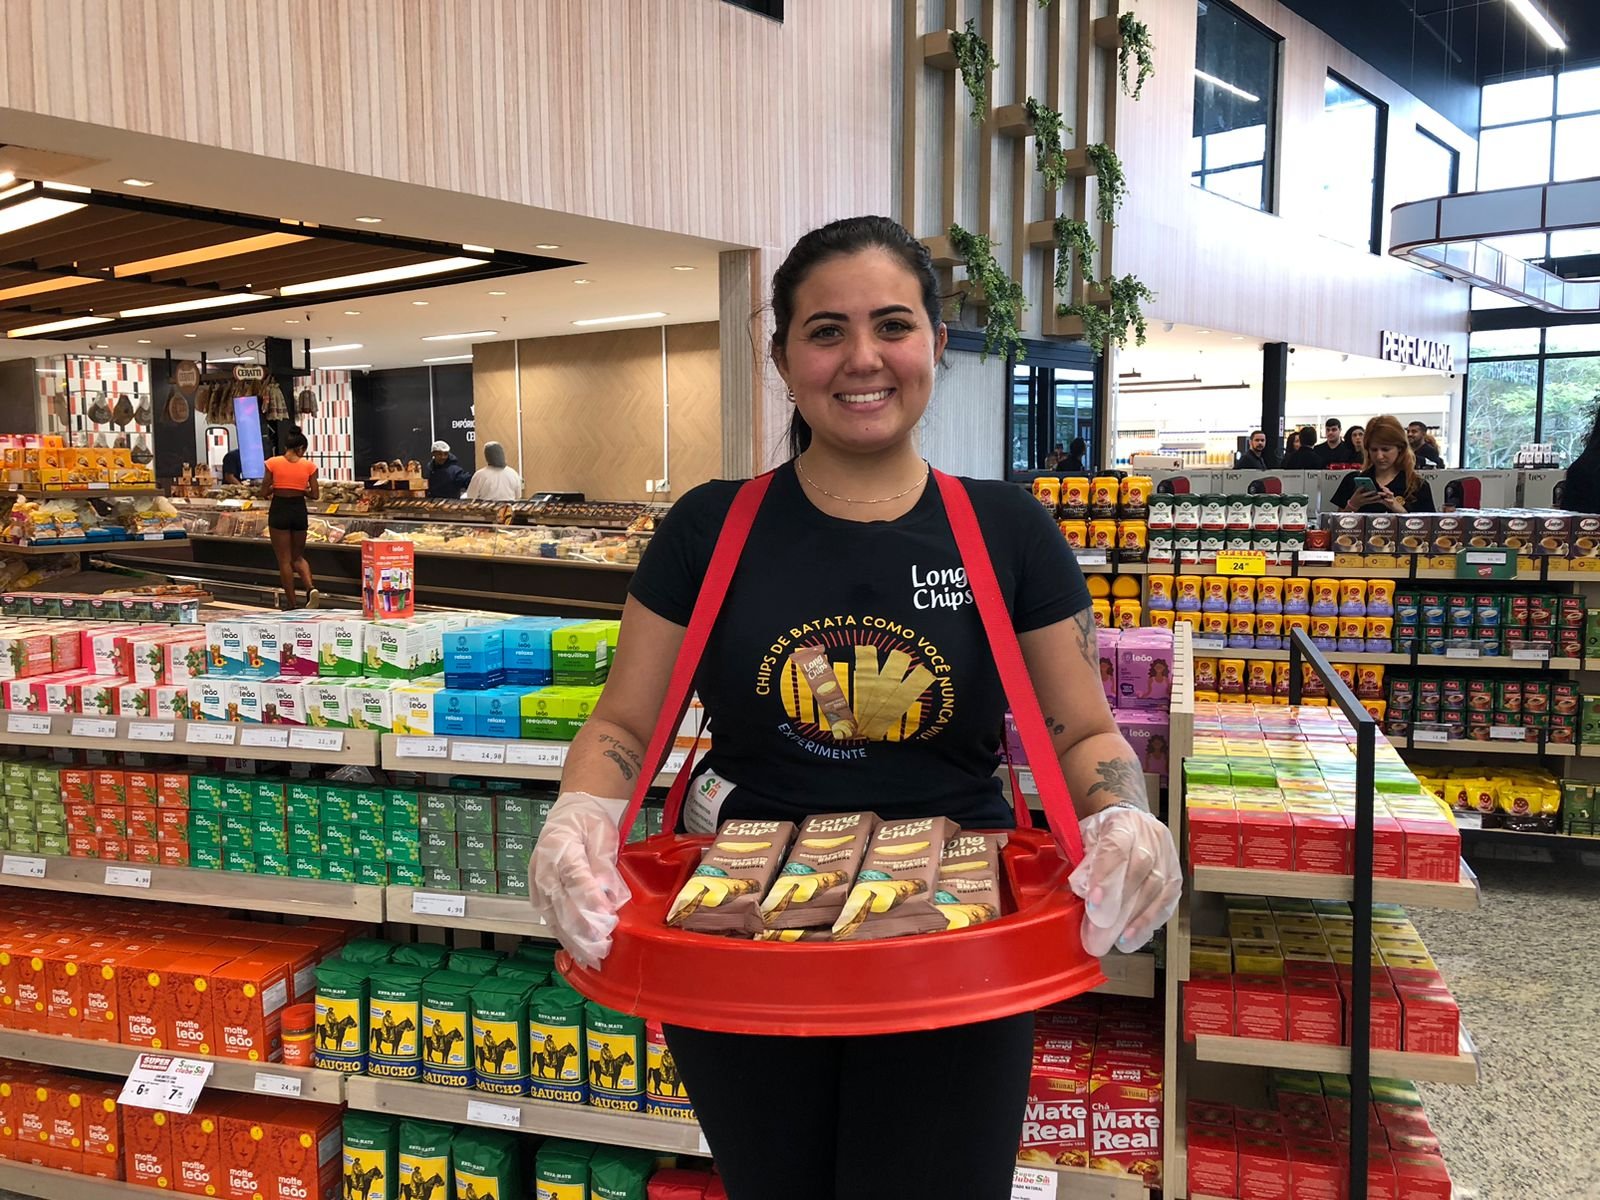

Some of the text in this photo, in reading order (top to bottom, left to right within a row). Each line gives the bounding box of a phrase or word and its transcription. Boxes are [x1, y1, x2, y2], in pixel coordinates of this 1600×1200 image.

[1380, 330, 1454, 371] PERFUMARIA
[912, 565, 967, 588] Long
[914, 587, 973, 610] Chips
[803, 654, 823, 672] Long
[1132, 654, 1152, 662] leão
[756, 655, 777, 695] CHIPS
[770, 636, 790, 654] DE
[790, 615, 856, 638] BATATA
[862, 616, 915, 639] COMO
[917, 636, 950, 673] VOCÊ
[937, 676, 954, 724] NUNCA
[808, 663, 828, 680] Chips
[1130, 729, 1150, 737] leão
[778, 722, 868, 759] EXPERIMENTE
[809, 814, 861, 826] Long
[880, 819, 933, 833] Long
[723, 828, 777, 836] Chips
[806, 822, 858, 832] Chips
[878, 826, 931, 840] Chips
[946, 836, 984, 849] ong
[129, 1015, 152, 1023] matte
[176, 1020, 199, 1029] matte
[129, 1022, 156, 1035] leão
[176, 1028, 204, 1041] leão
[224, 1026, 248, 1035] matte
[224, 1034, 253, 1047] leão
[144, 1056, 171, 1066] SUPER
[531, 1086, 581, 1102] GAUCHO
[1024, 1104, 1088, 1120] Mate
[1092, 1112, 1160, 1129] Mate
[1023, 1120, 1085, 1142] Real
[1093, 1129, 1158, 1150] Real
[135, 1153, 158, 1162] matte
[135, 1161, 162, 1174] leão
[182, 1161, 205, 1170] matte
[182, 1169, 210, 1182] leão
[230, 1169, 253, 1178] matte
[230, 1176, 258, 1190] leão
[278, 1176, 302, 1186] matte
[279, 1184, 307, 1198] leão
